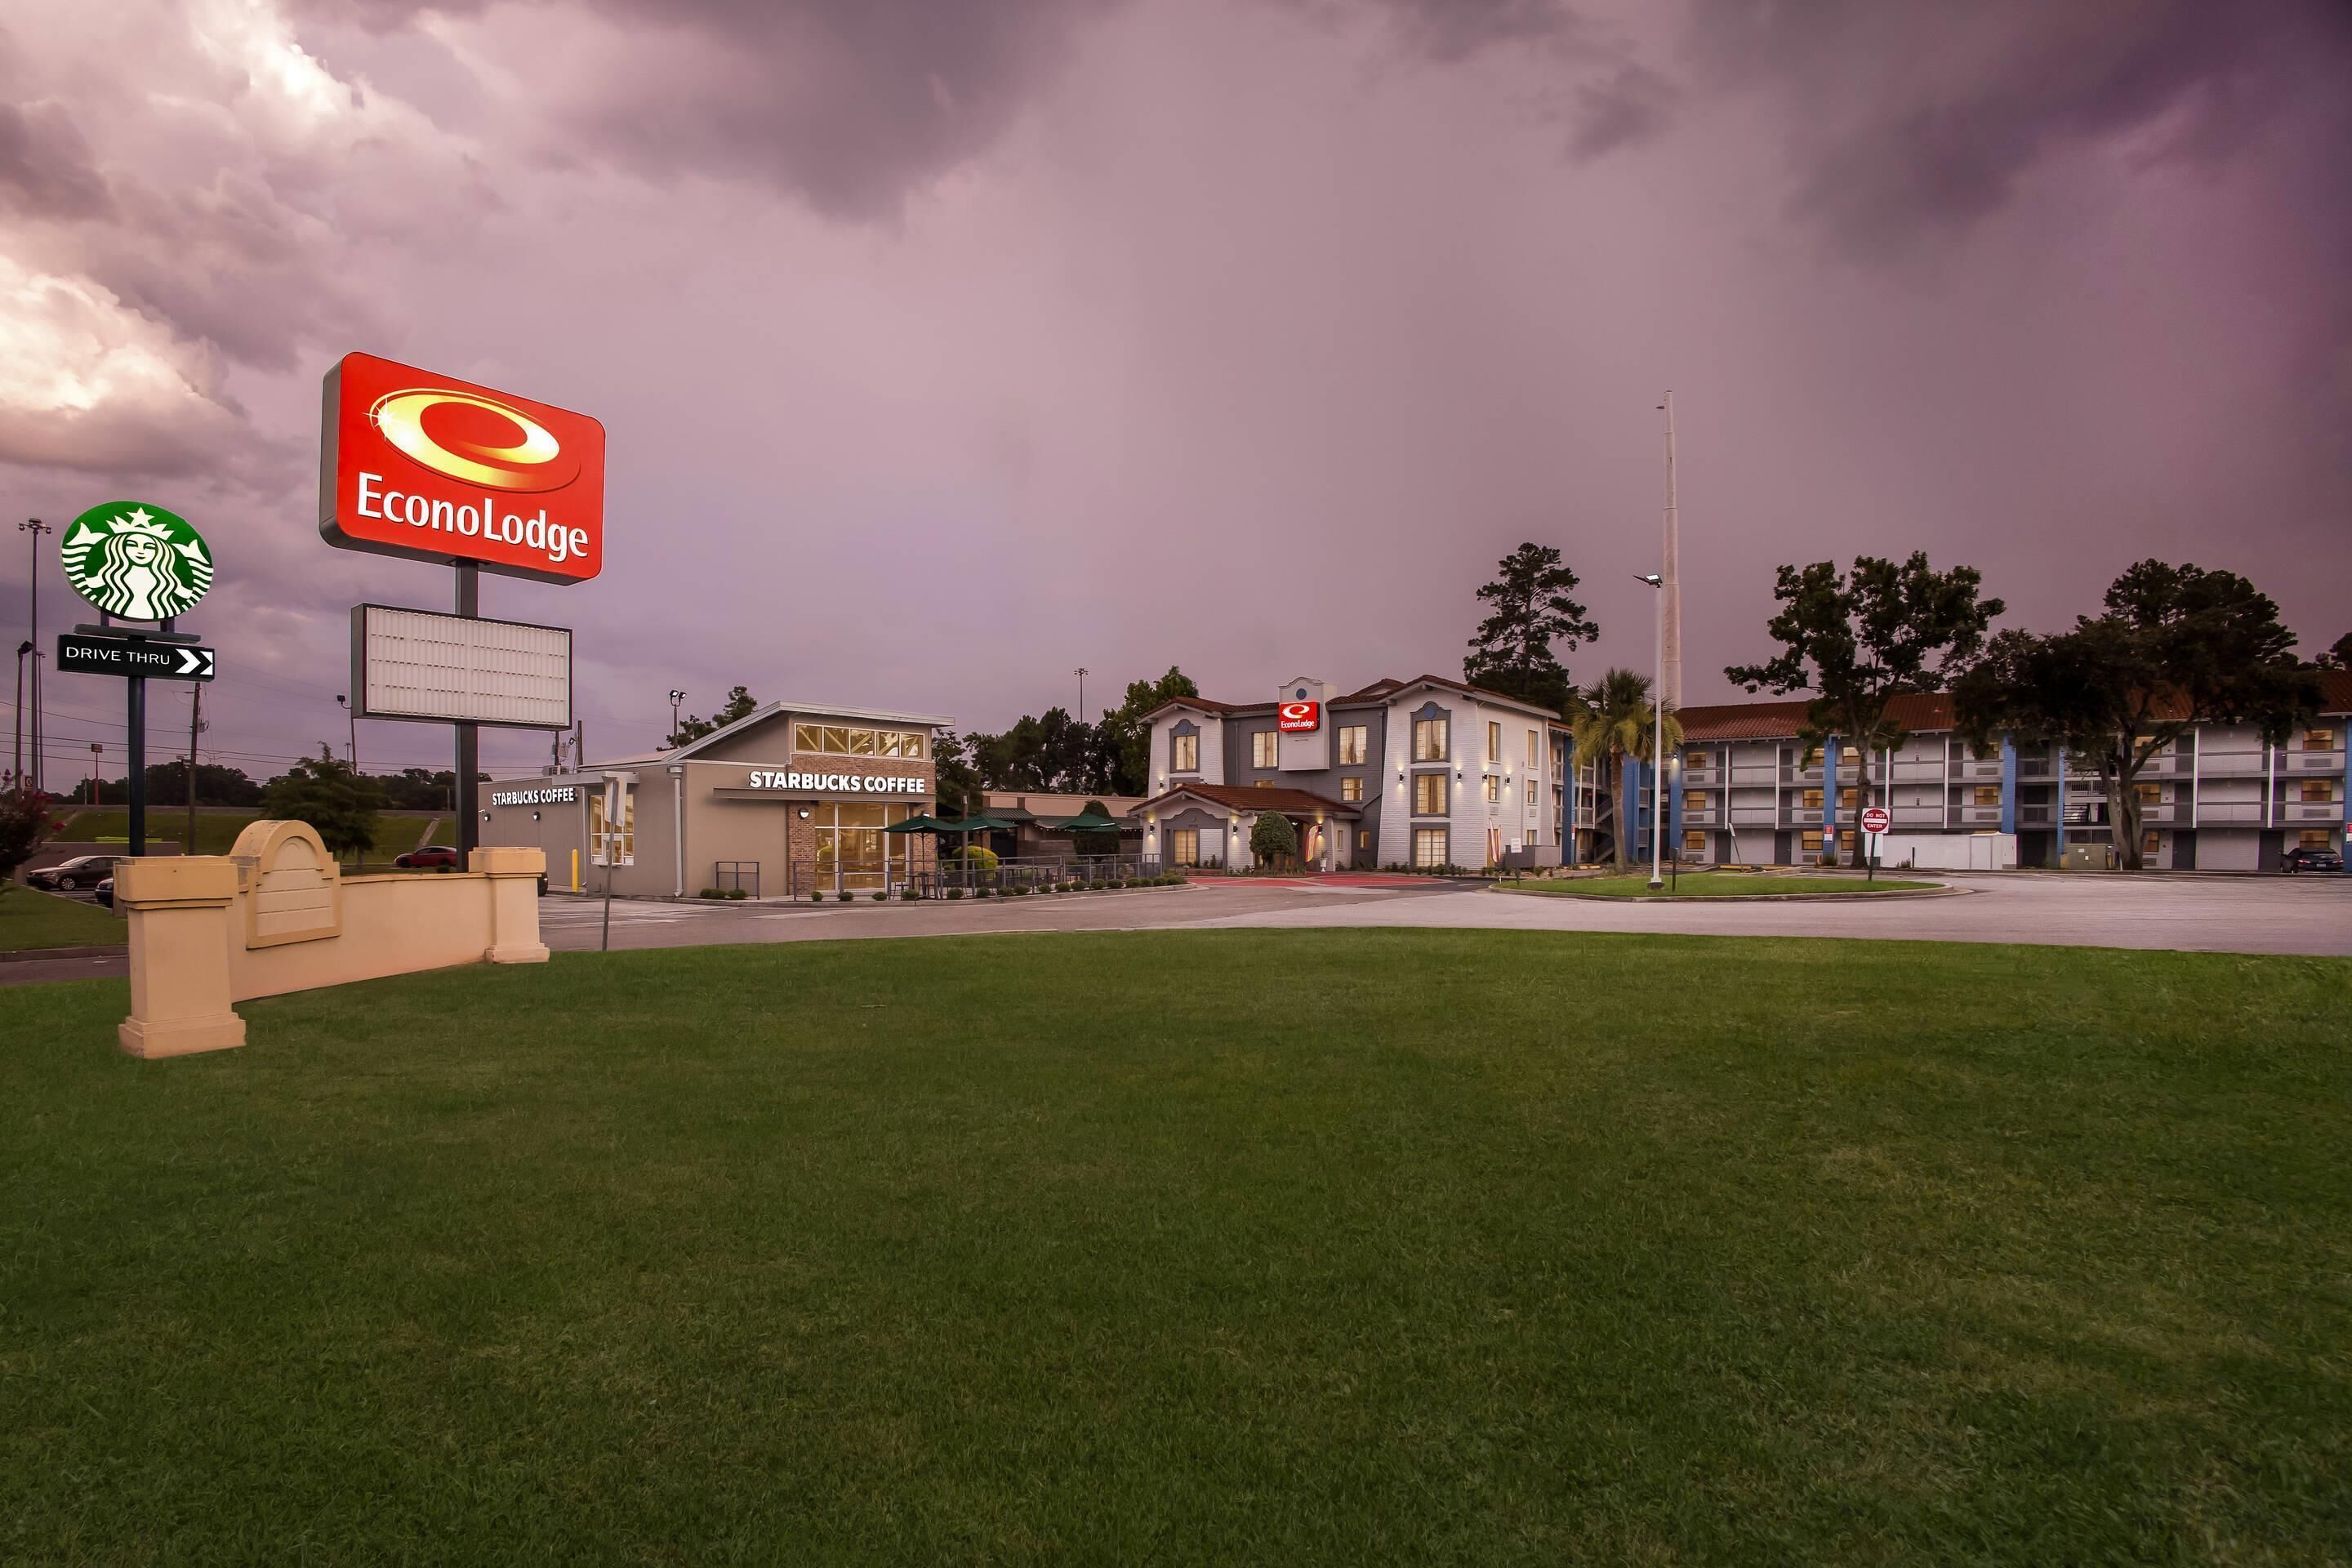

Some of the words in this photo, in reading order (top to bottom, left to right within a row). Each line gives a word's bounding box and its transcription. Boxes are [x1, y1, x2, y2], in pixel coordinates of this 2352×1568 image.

[66, 647, 122, 662] DRIVE
[126, 652, 170, 665] THRU
[750, 771, 861, 791] STARBUCKS
[863, 776, 925, 793] COFFEE
[492, 790, 539, 805] STARBUCKS
[540, 787, 574, 803] COFFEE
